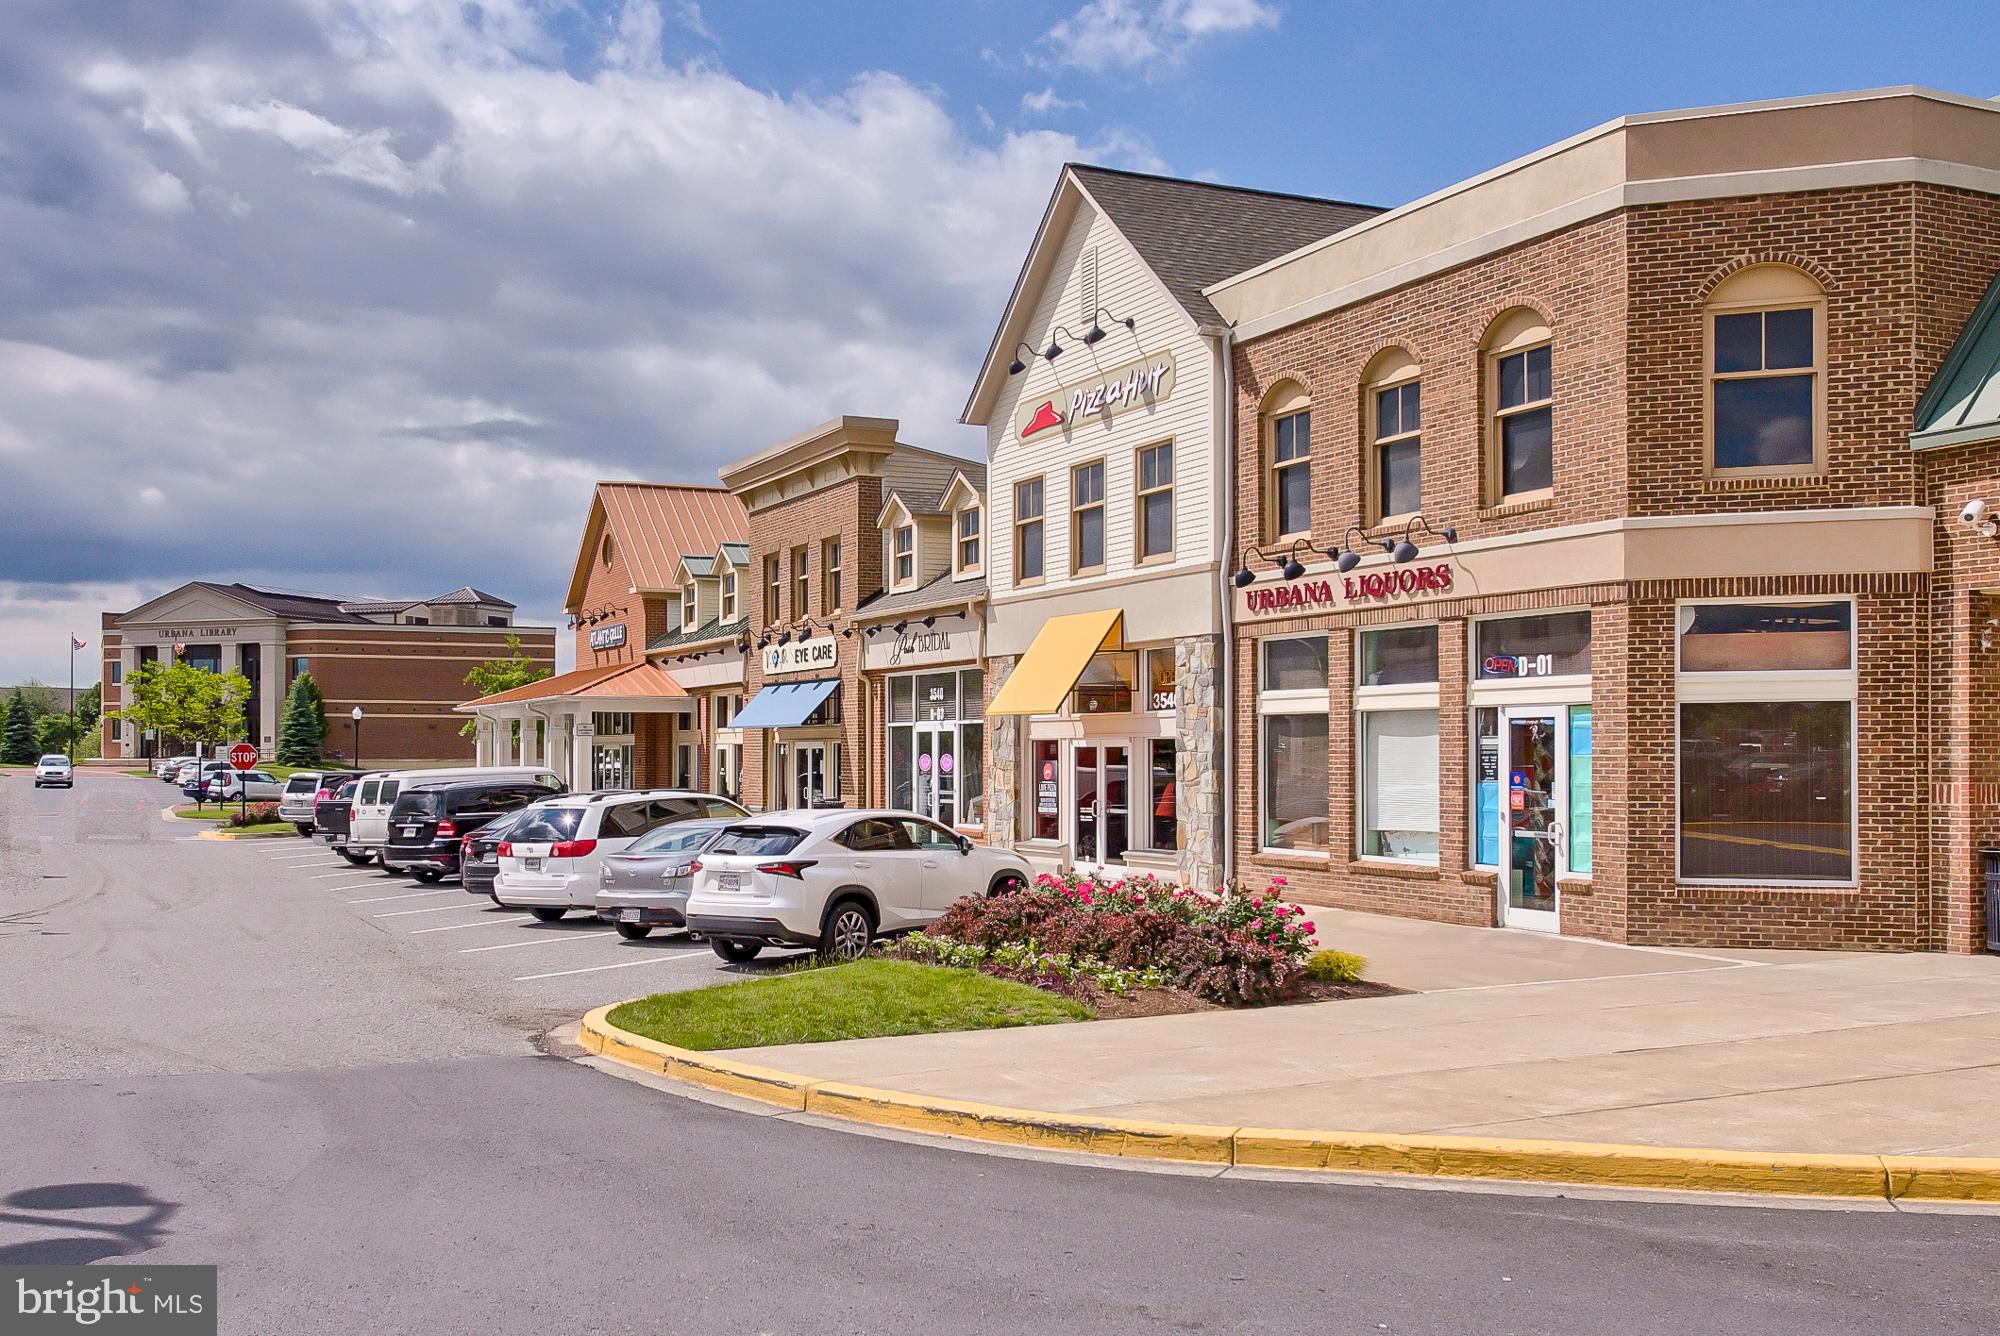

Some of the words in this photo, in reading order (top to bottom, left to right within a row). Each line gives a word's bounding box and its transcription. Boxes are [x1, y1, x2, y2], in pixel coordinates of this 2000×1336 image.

[1246, 580, 1333, 611] URBANA
[1344, 563, 1451, 599] LIQUORS
[158, 629, 194, 638] URBANA
[200, 628, 237, 637] LIBRARY
[795, 647, 809, 664] EYE
[812, 644, 833, 661] CARE
[1483, 657, 1517, 673] OPEN
[1518, 654, 1552, 677] D-01
[929, 687, 944, 701] 3540
[1153, 692, 1176, 709] 354
[231, 752, 256, 763] STOP
